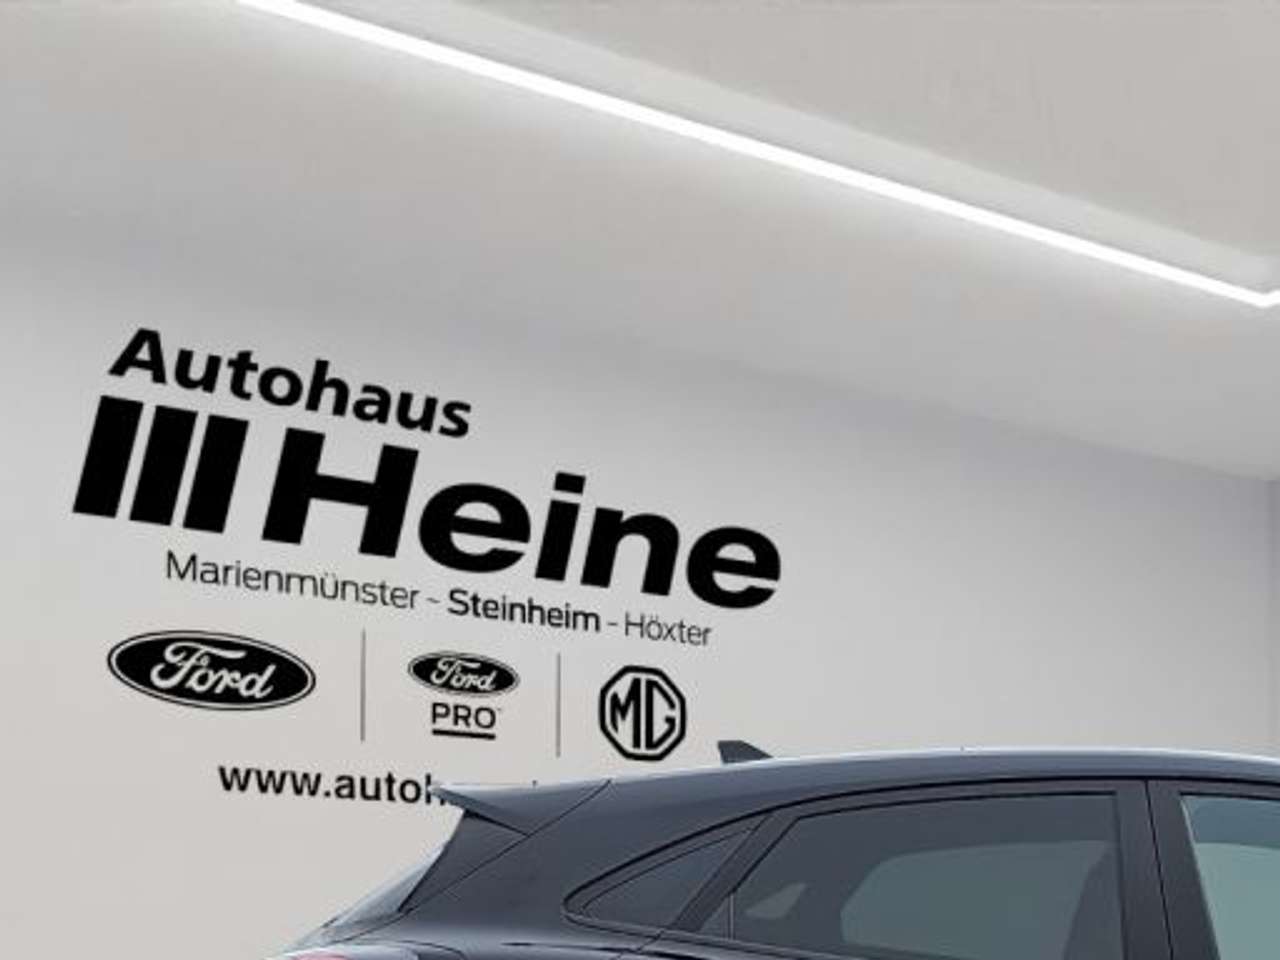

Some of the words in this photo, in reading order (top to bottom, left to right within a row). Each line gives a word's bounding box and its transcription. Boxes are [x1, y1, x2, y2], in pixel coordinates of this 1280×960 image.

[108, 327, 472, 437] Autohaus
[261, 426, 781, 609] Heine
[165, 549, 419, 610] Marienmünster
[447, 588, 601, 632] Steinheim
[624, 612, 712, 646] Höxter
[150, 641, 277, 699] Ford
[430, 656, 495, 691] Ford
[431, 702, 496, 729] PRO
[609, 676, 676, 751] MG
